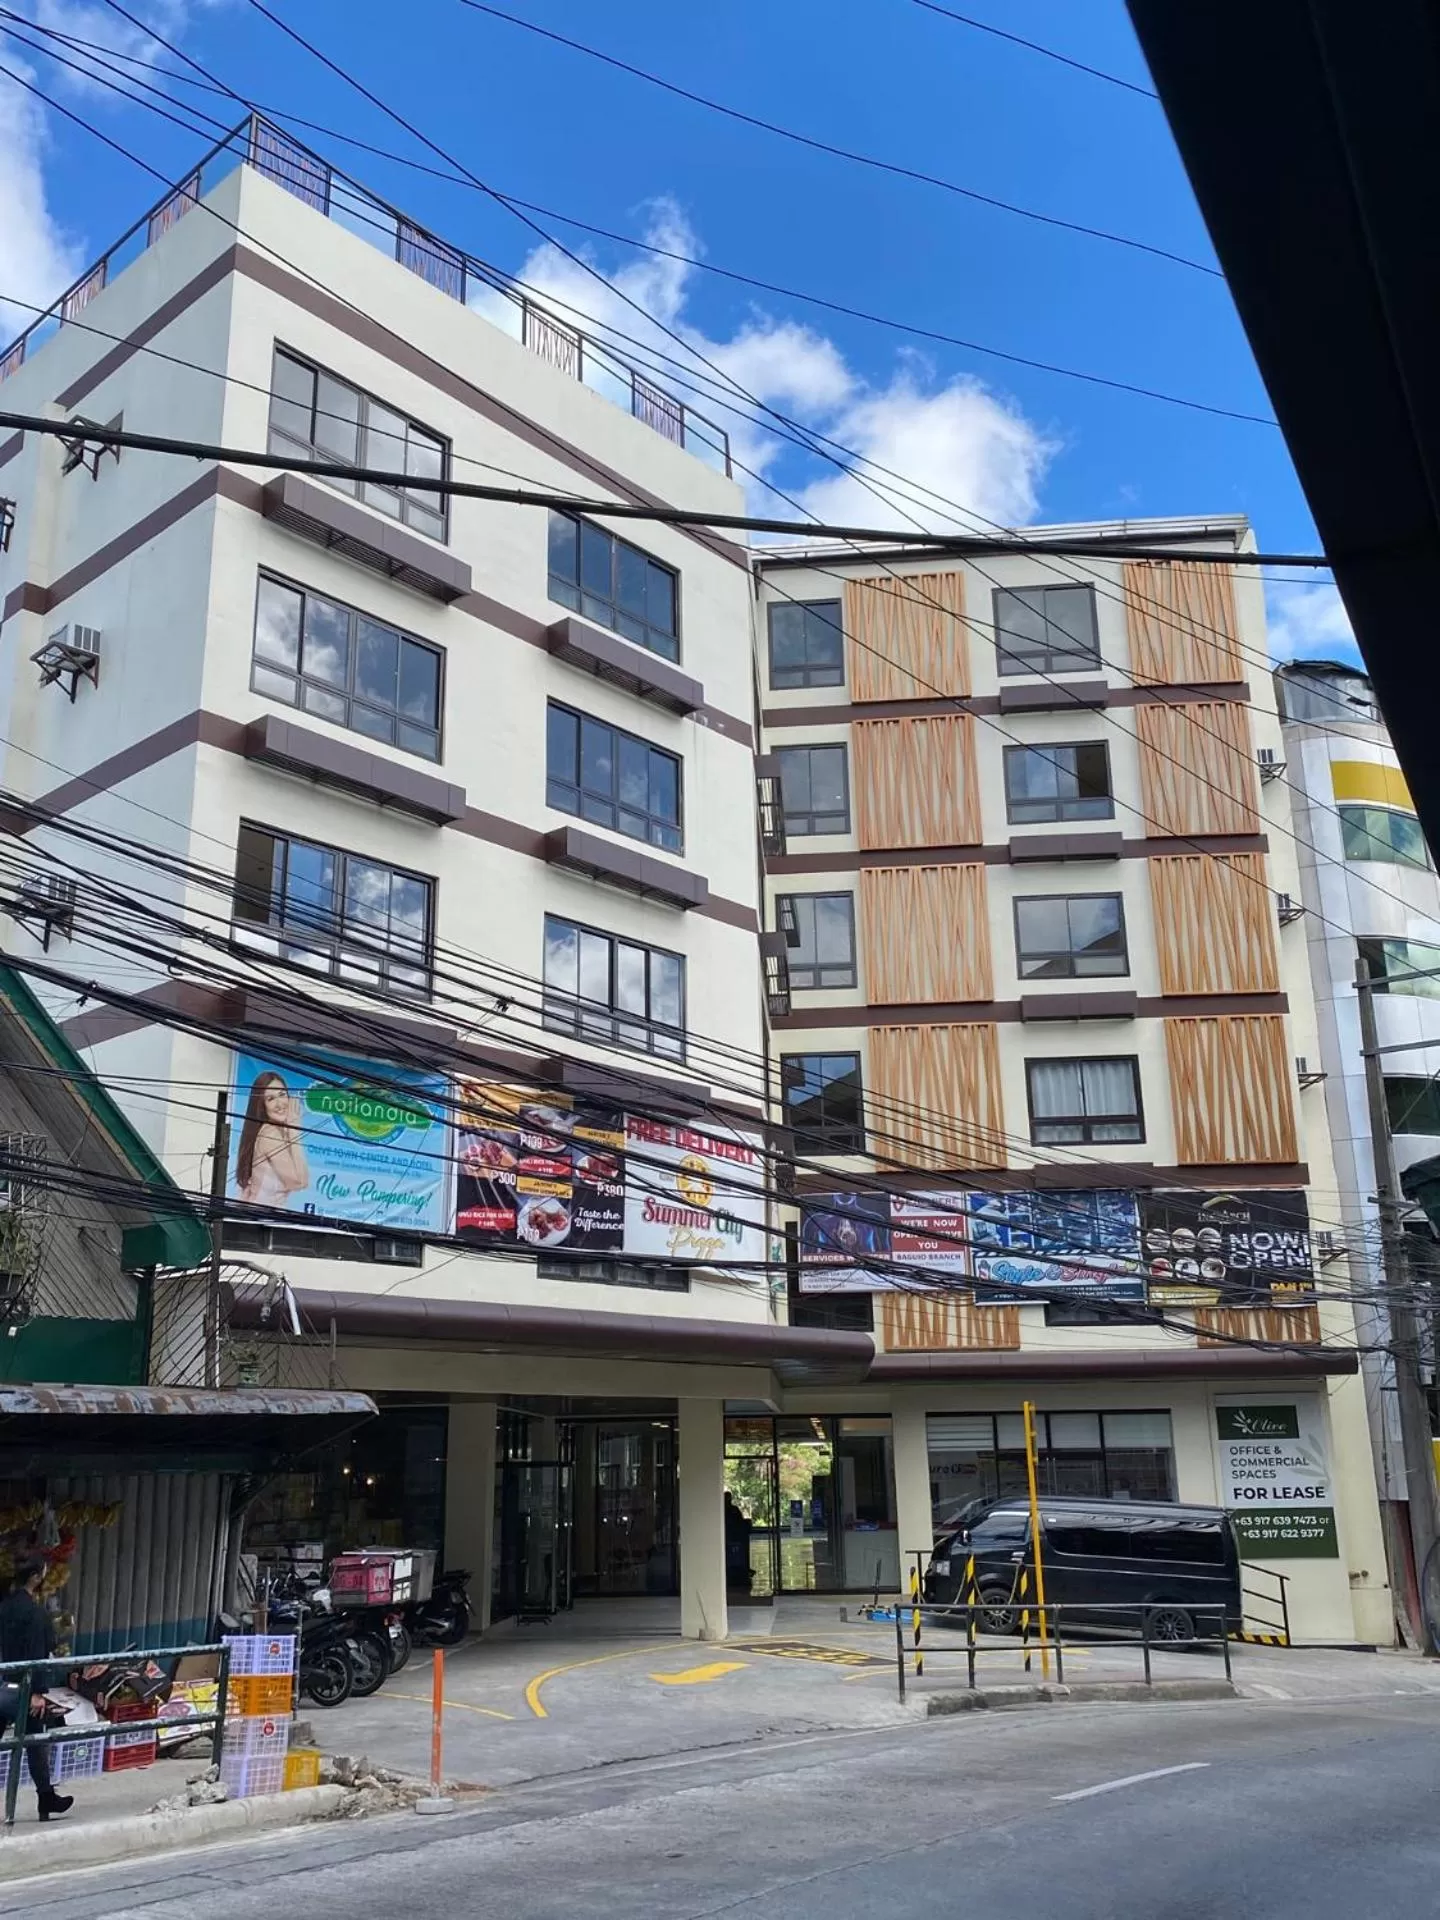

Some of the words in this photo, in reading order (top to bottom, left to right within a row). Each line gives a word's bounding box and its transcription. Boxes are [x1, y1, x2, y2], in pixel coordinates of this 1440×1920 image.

[627, 1116, 671, 1144] FREE
[676, 1128, 754, 1165] DELIVERY
[316, 1172, 350, 1200] Now
[357, 1179, 433, 1214] Pampering!
[578, 1206, 602, 1219] Taste
[603, 1209, 622, 1220] the
[574, 1216, 625, 1233] Difference
[642, 1195, 712, 1231] Summer
[715, 1206, 744, 1244] City
[933, 1219, 957, 1227] NOW
[918, 1241, 938, 1249] YOU
[803, 1254, 846, 1262] SERVICES
[1229, 1445, 1271, 1455] OFFICE
[1274, 1445, 1282, 1455] &
[1230, 1457, 1310, 1467] COMMERCIAL
[1231, 1469, 1277, 1479] SPACES
[1233, 1487, 1268, 1500] FOR
[1272, 1486, 1326, 1499] LEASE
[1235, 1516, 1253, 1525] +63
[1254, 1516, 1271, 1525] 917
[1272, 1516, 1291, 1525] 639
[1292, 1516, 1317, 1525] 7473
[1242, 1529, 1260, 1538] +63
[1261, 1529, 1278, 1538] 917
[1280, 1529, 1299, 1538] 622
[1300, 1529, 1325, 1538] 9377
